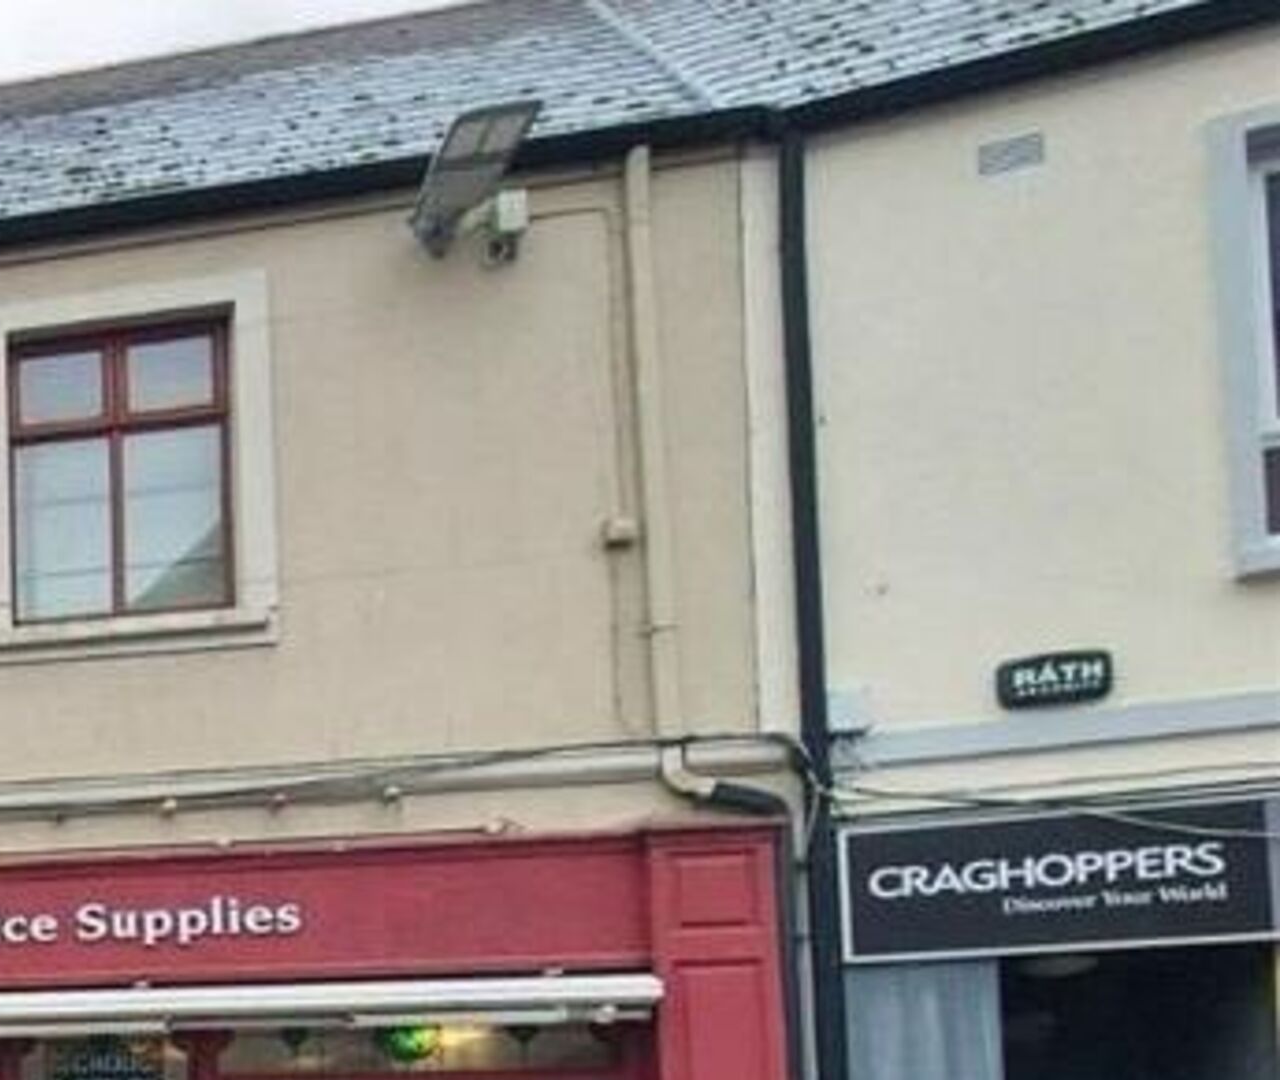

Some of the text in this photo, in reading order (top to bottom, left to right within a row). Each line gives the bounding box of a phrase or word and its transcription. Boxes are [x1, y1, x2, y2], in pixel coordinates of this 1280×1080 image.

[868, 842, 1226, 899] CRAGHOPPERS
[75, 896, 302, 945] Supplies
[1002, 881, 1228, 915] Discover Your World
